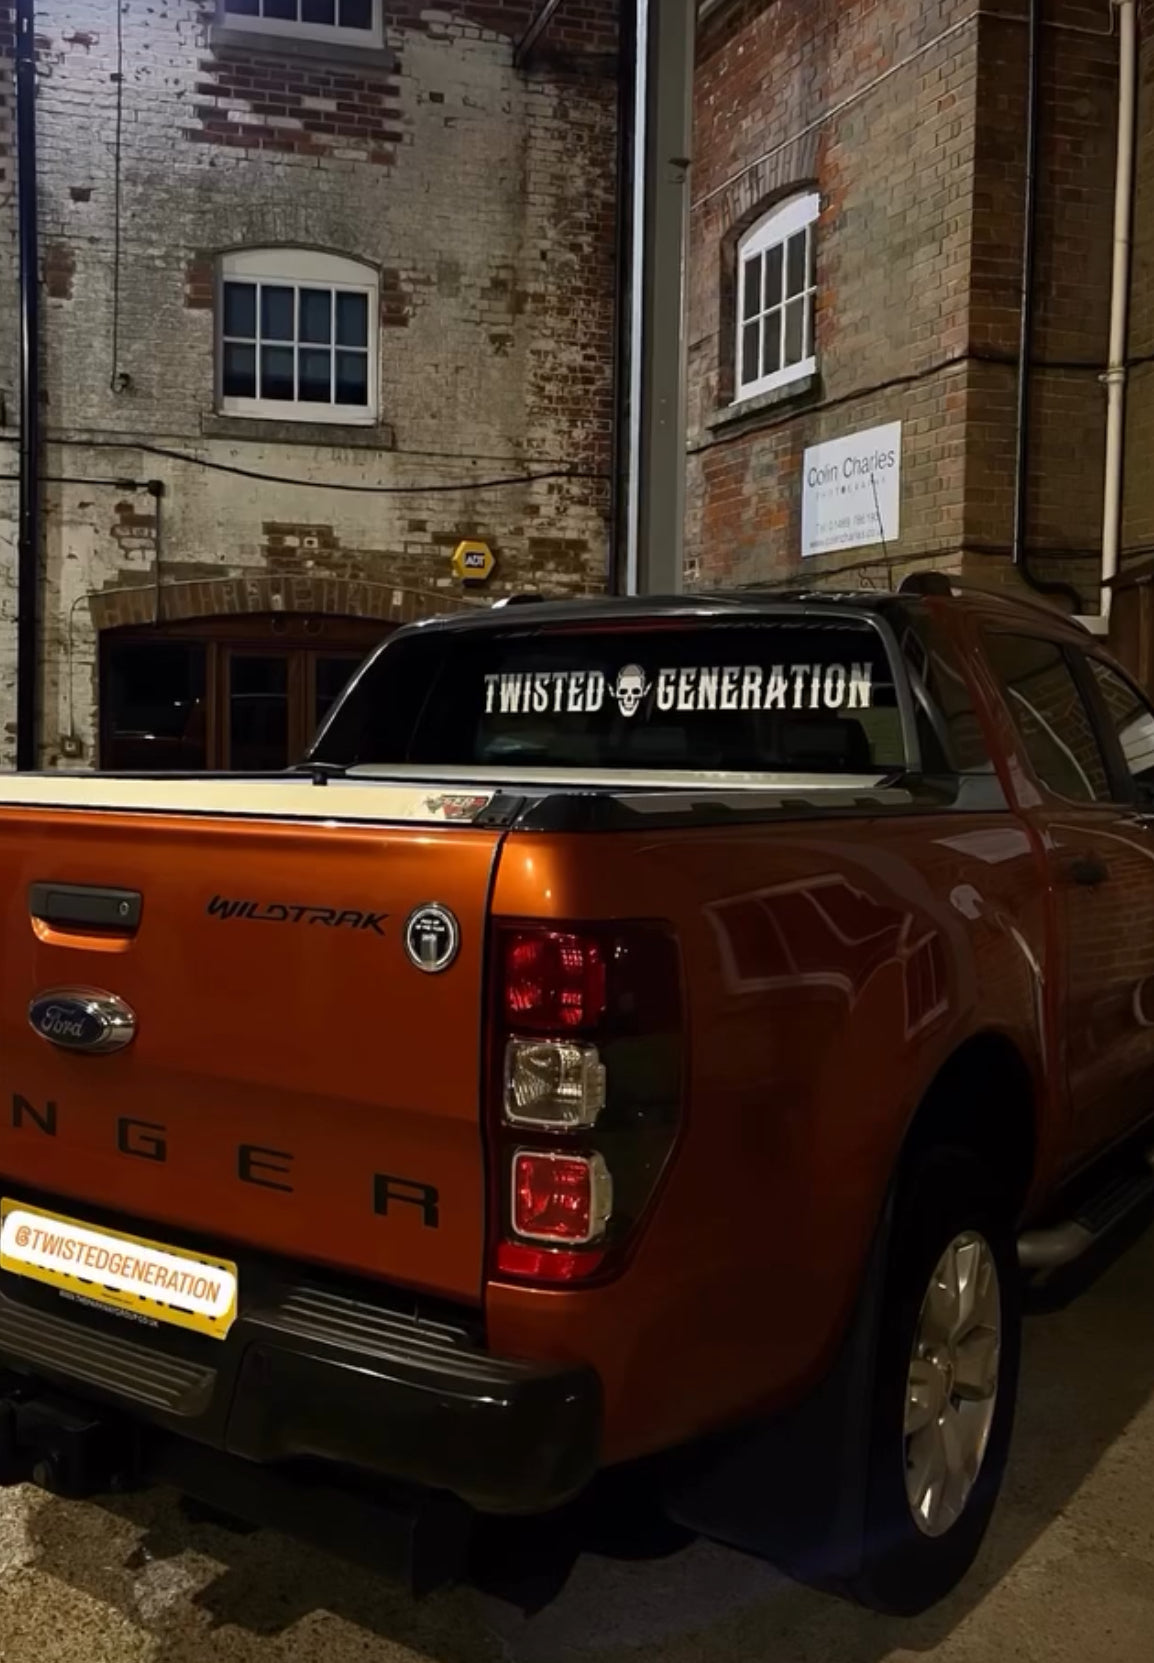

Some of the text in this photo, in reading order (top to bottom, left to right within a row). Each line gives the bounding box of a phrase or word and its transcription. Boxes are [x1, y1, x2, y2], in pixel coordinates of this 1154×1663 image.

[807, 450, 895, 488] Colin Charles
[484, 662, 874, 714] TWISTED GENERATION
[206, 894, 390, 936] WILDTRAK
[41, 1005, 87, 1037] Ford
